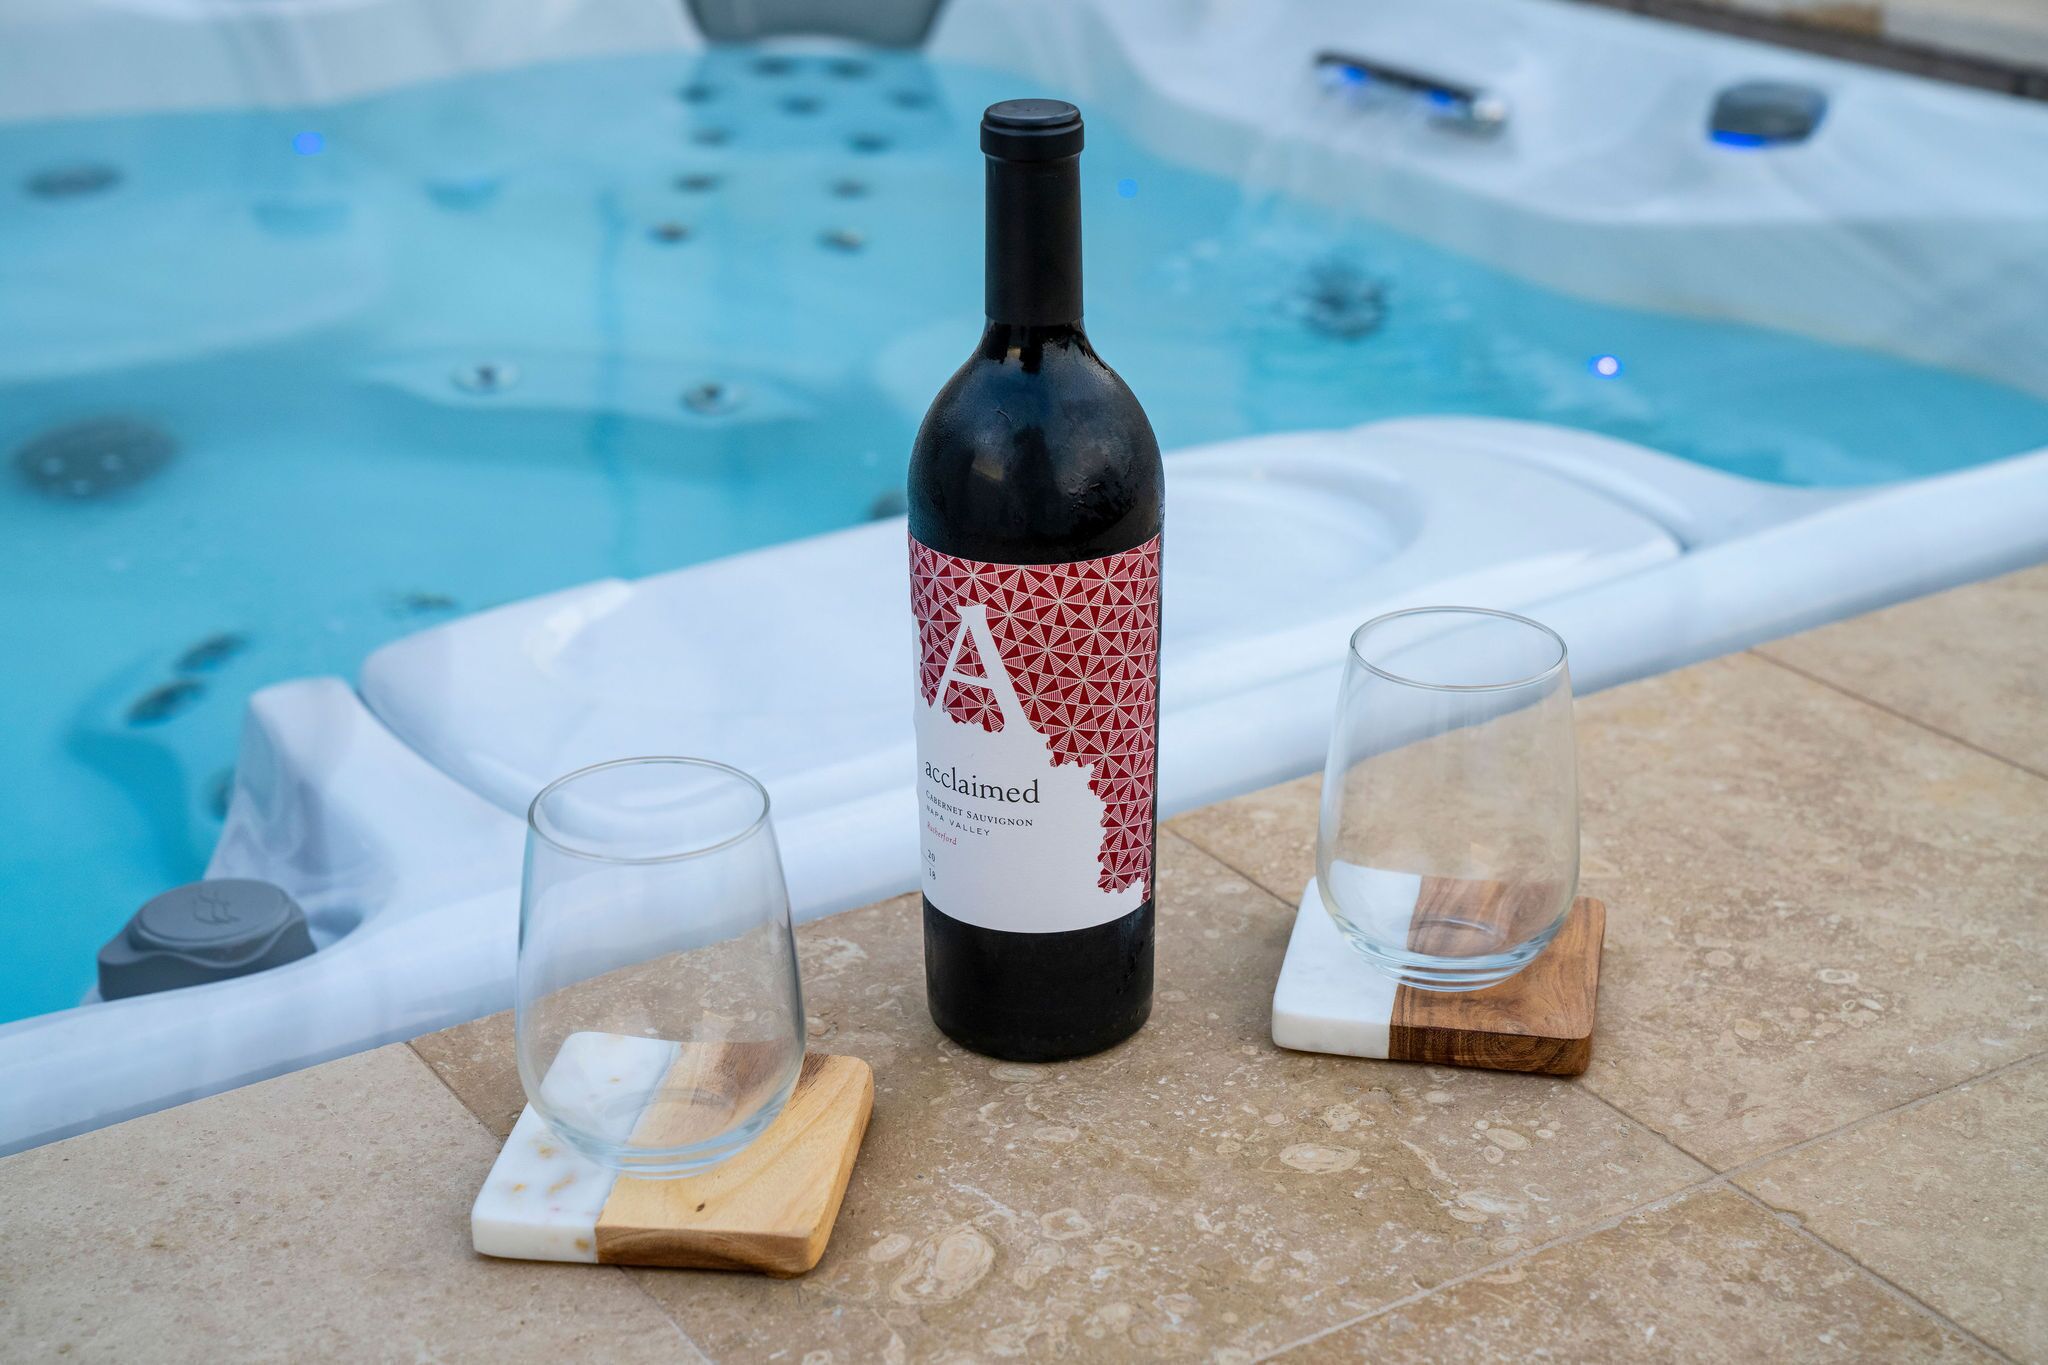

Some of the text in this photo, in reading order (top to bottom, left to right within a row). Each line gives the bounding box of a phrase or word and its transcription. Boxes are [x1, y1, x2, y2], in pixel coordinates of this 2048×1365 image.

[932, 604, 1033, 731] A
[925, 761, 1040, 804] acclaimed
[925, 789, 1033, 827] CABERNET SAUVIGNON
[926, 804, 990, 837] NAPA VALLEY
[927, 849, 936, 862] 20
